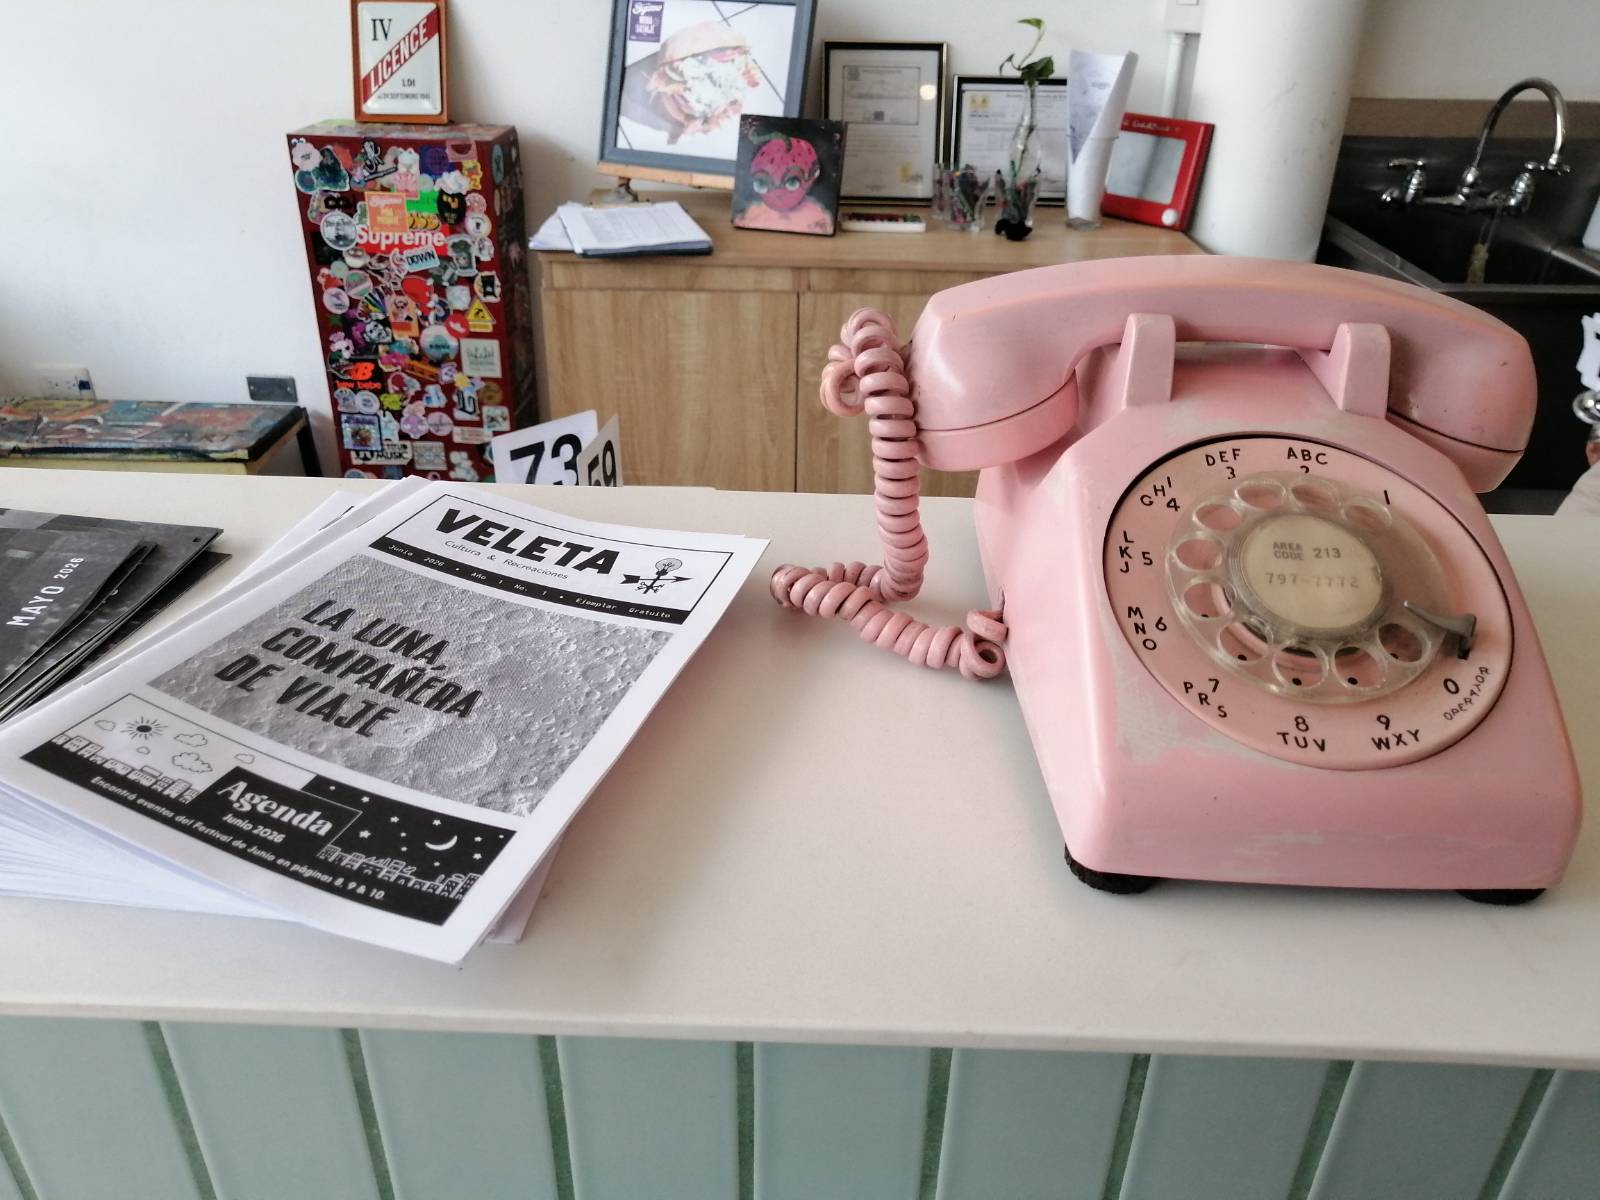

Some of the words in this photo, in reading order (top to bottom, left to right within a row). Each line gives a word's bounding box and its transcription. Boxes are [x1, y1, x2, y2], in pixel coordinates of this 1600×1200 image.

[371, 18, 392, 41] IV
[370, 18, 428, 93] LICENCE
[356, 226, 446, 250] Supreme
[406, 250, 436, 266] DOWN
[510, 433, 582, 486] 73
[1205, 448, 1240, 466] DEF
[1287, 447, 1328, 465] ABC
[1226, 466, 1236, 480] 3
[1166, 497, 1181, 512] 4
[1383, 489, 1391, 505] 1
[436, 508, 620, 575] VELETA
[1272, 541, 1303, 552] AREA
[444, 540, 481, 557] Cultura
[486, 554, 497, 562] &
[503, 558, 569, 580] Recreaciones
[1142, 551, 1153, 566] 5
[1273, 550, 1304, 562] CODE
[1313, 547, 1342, 559] 213
[5, 585, 65, 626] MAYO
[53, 557, 84, 579] 2026
[389, 544, 414, 557] Junio
[424, 556, 445, 568] 2026
[470, 571, 487, 581] Año
[575, 597, 618, 611] Ejemplar
[628, 607, 671, 619] Gratuito
[302, 600, 356, 632] LA
[1155, 616, 1168, 631] 6
[261, 626, 483, 719] COMPAÑERA
[214, 654, 285, 693] DE
[276, 675, 400, 738] VIAJE
[1207, 678, 1220, 693] 7
[1442, 666, 1490, 721] OPERATOR
[1294, 715, 1310, 732] 8
[1376, 714, 1391, 730] 9
[1276, 731, 1326, 752] TUV
[1371, 729, 1421, 751] WXY
[217, 780, 333, 837] Agenda
[222, 813, 254, 832] Junio
[252, 824, 286, 844] 2026
[136, 797, 176, 819] eventos
[174, 814, 193, 827] del
[192, 820, 234, 844] Festival
[231, 838, 247, 850] de
[247, 845, 276, 862] Junio
[276, 856, 291, 868] en
[346, 881, 357, 890] 9
